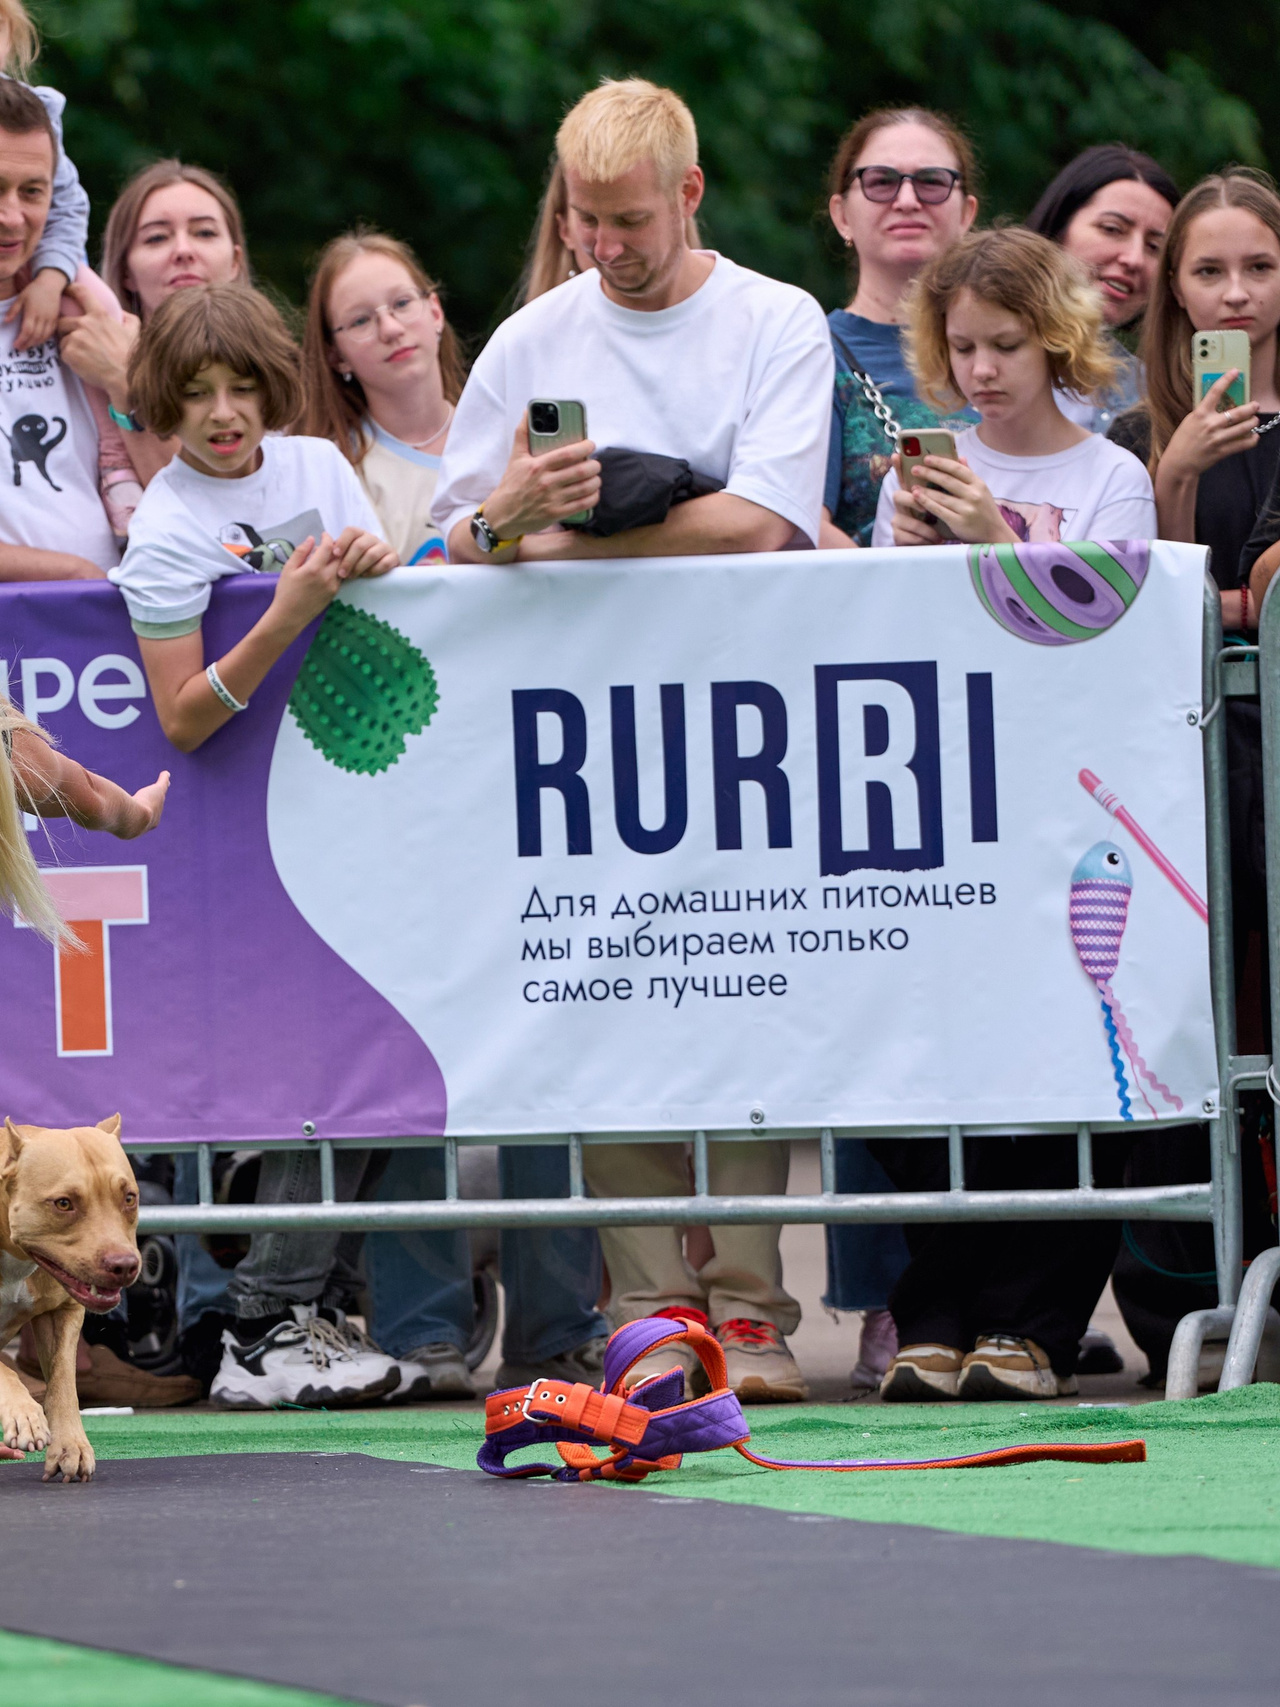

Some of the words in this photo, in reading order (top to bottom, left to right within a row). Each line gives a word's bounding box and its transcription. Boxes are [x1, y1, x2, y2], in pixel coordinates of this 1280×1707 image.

[511, 670, 999, 858] RURRI
[521, 885, 596, 923] Для
[611, 887, 808, 919] домашних
[823, 882, 997, 910] питомцев
[521, 938, 571, 961] мы
[588, 921, 775, 965] выбираем
[787, 927, 909, 952] только
[523, 976, 633, 1003] самое
[647, 973, 788, 1008] лучшее
